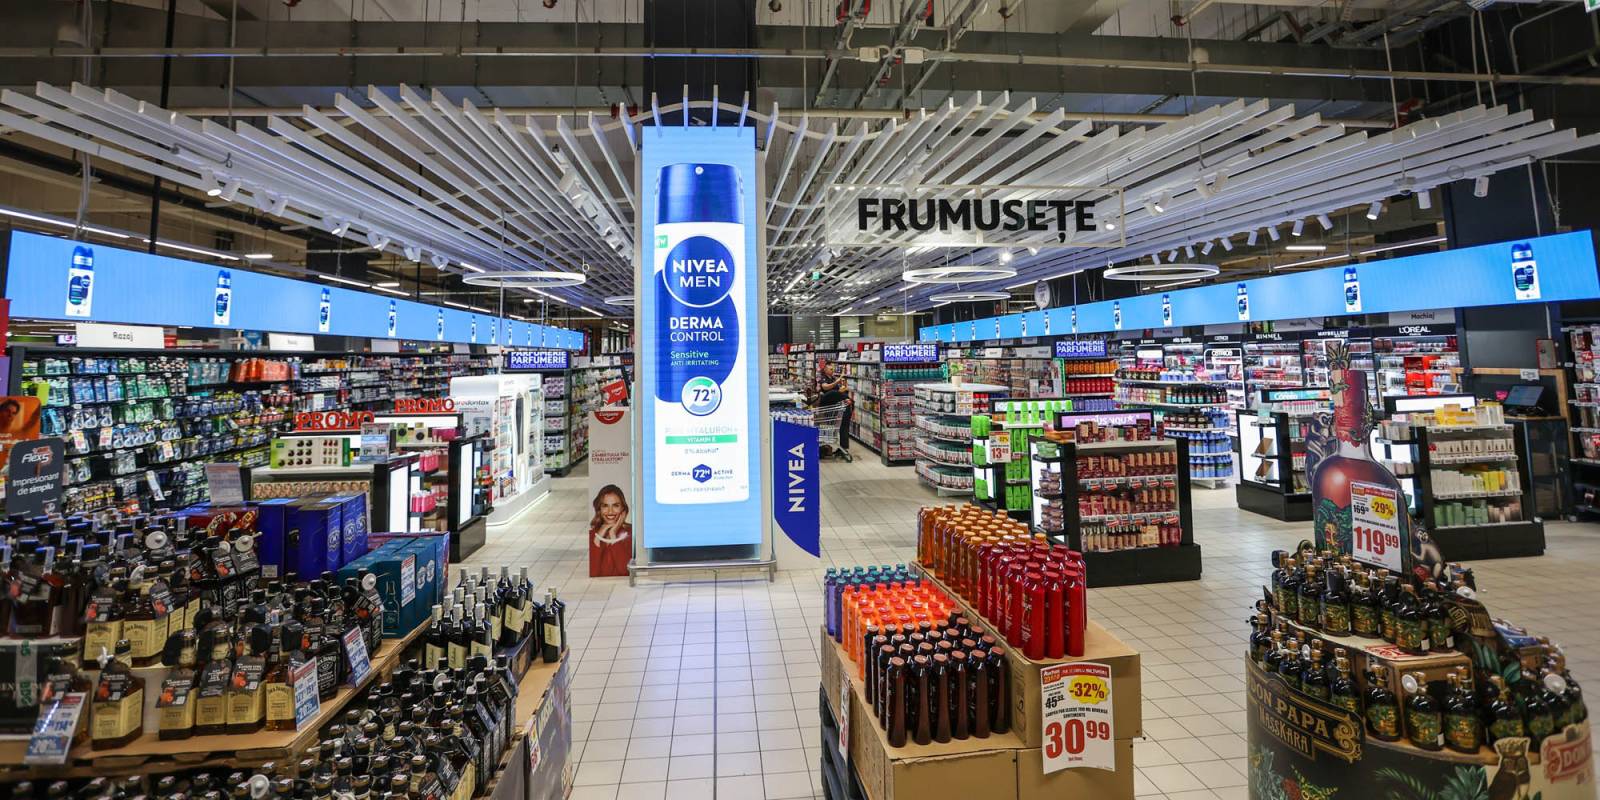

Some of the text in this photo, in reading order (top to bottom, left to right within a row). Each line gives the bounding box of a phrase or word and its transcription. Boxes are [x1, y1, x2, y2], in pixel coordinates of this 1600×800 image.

[672, 259, 729, 273] NIVEA
[680, 276, 721, 288] MEN
[669, 317, 724, 330] DERMA
[670, 331, 725, 342] CONTROL
[511, 356, 567, 364] PARFUMERIE
[670, 350, 709, 359] Sensitive
[395, 398, 455, 413] PROMO
[295, 411, 375, 431] PROMO
[12, 472, 60, 487] Impresionant
[788, 442, 806, 512] NIVEA
[17, 483, 55, 496] de simplu
[1069, 682, 1105, 699] -32%
[1276, 697, 1329, 739] PAPA
